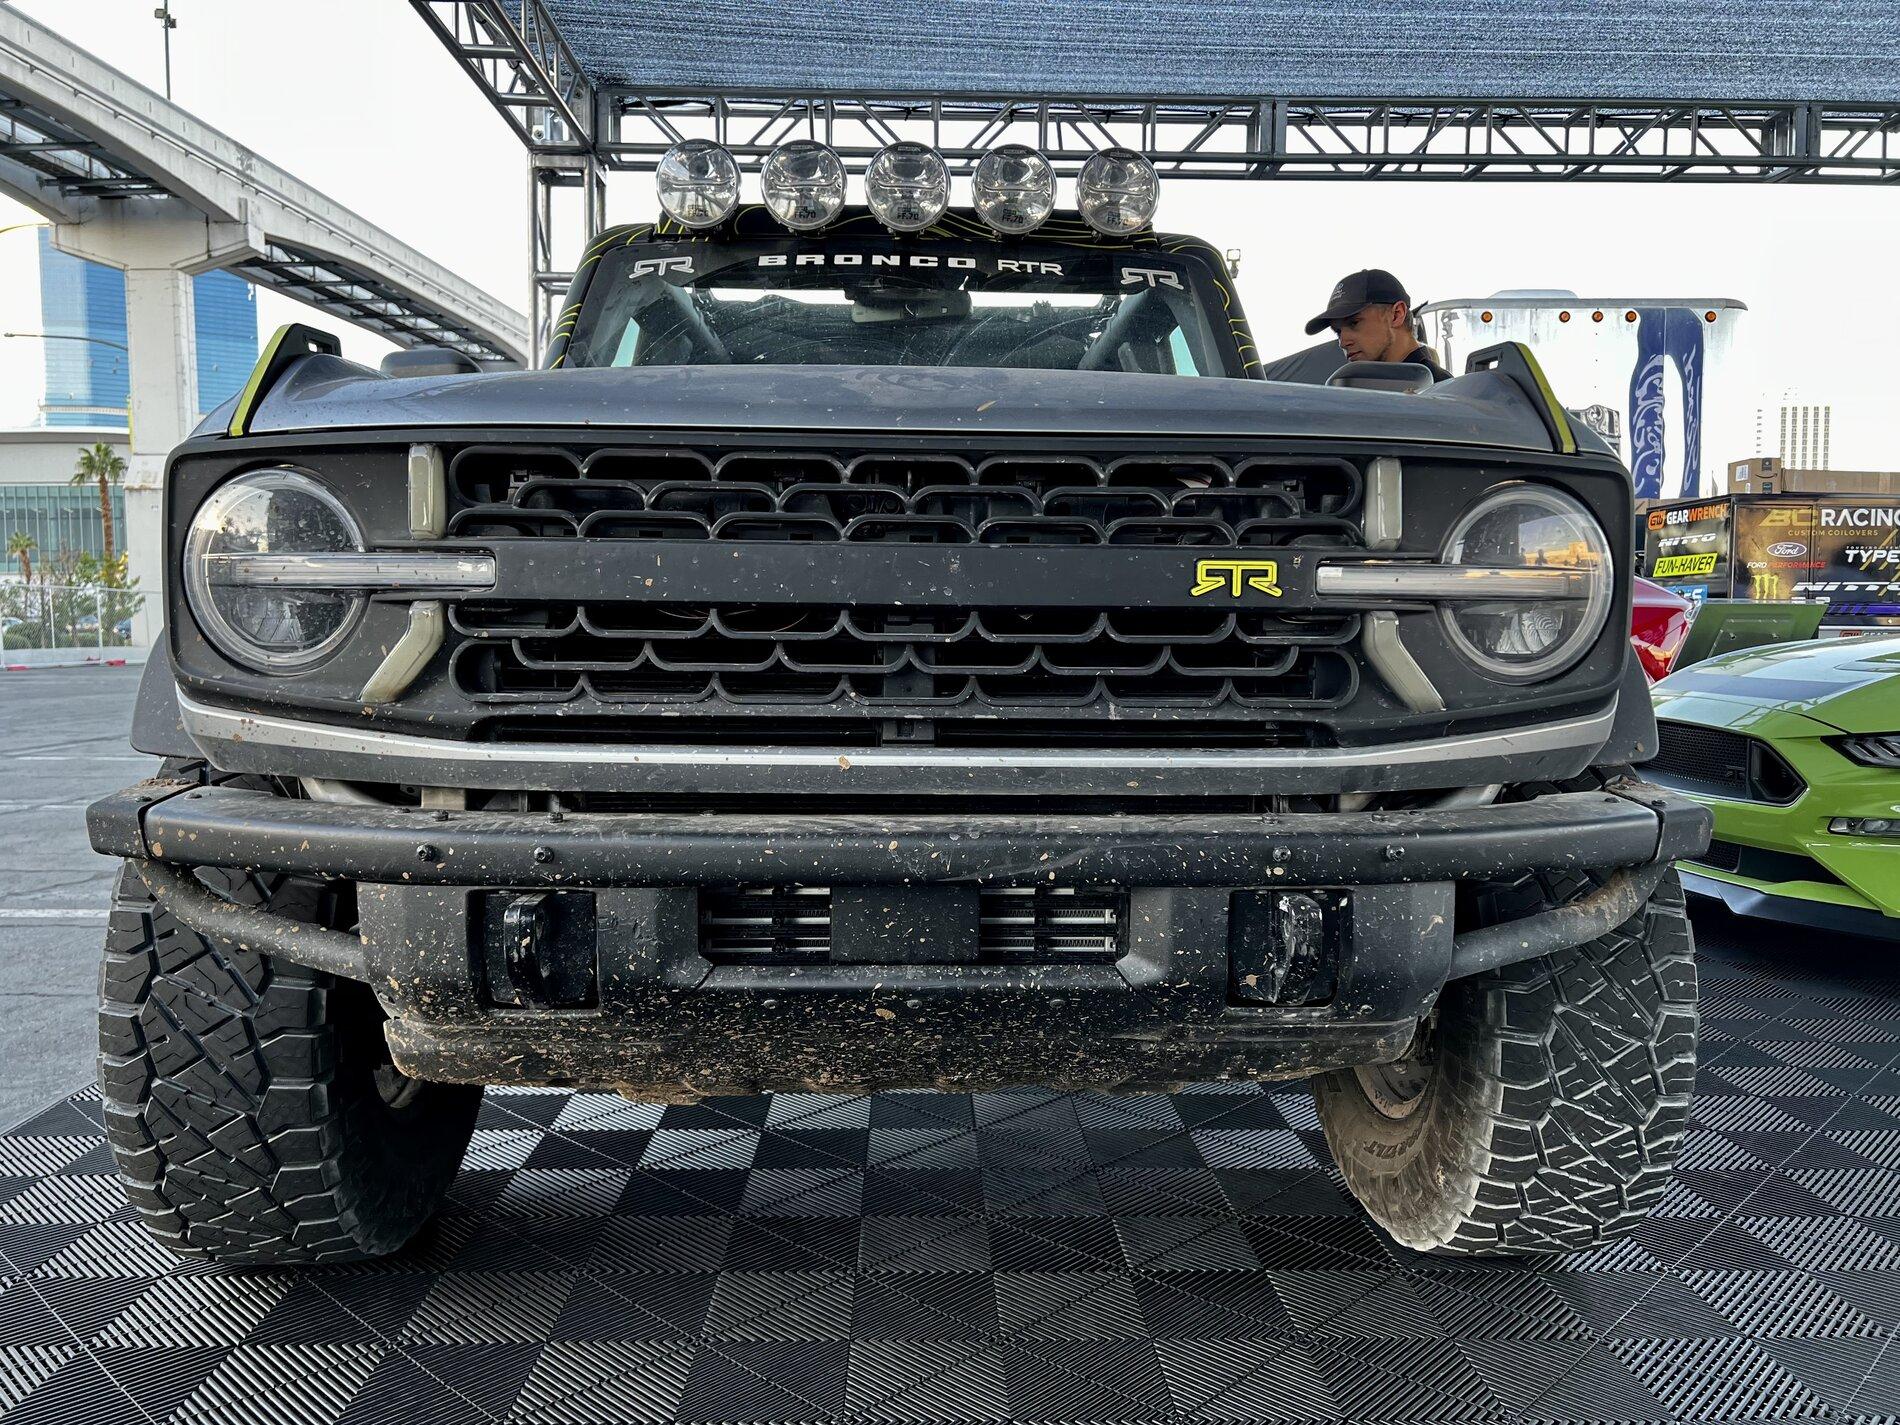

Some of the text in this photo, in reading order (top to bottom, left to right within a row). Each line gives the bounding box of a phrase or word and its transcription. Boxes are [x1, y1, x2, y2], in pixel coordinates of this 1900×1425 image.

[758, 254, 1064, 276] BRONCO RTR
[1666, 503, 1728, 525] GEARWRENCH
[1658, 533, 1717, 548] NITTO
[1773, 544, 1800, 556] Ford
[1845, 549, 1900, 563] TYPE
[1655, 556, 1714, 575] FUN-HAVER
[1769, 561, 1827, 569] PERFORMANCE
